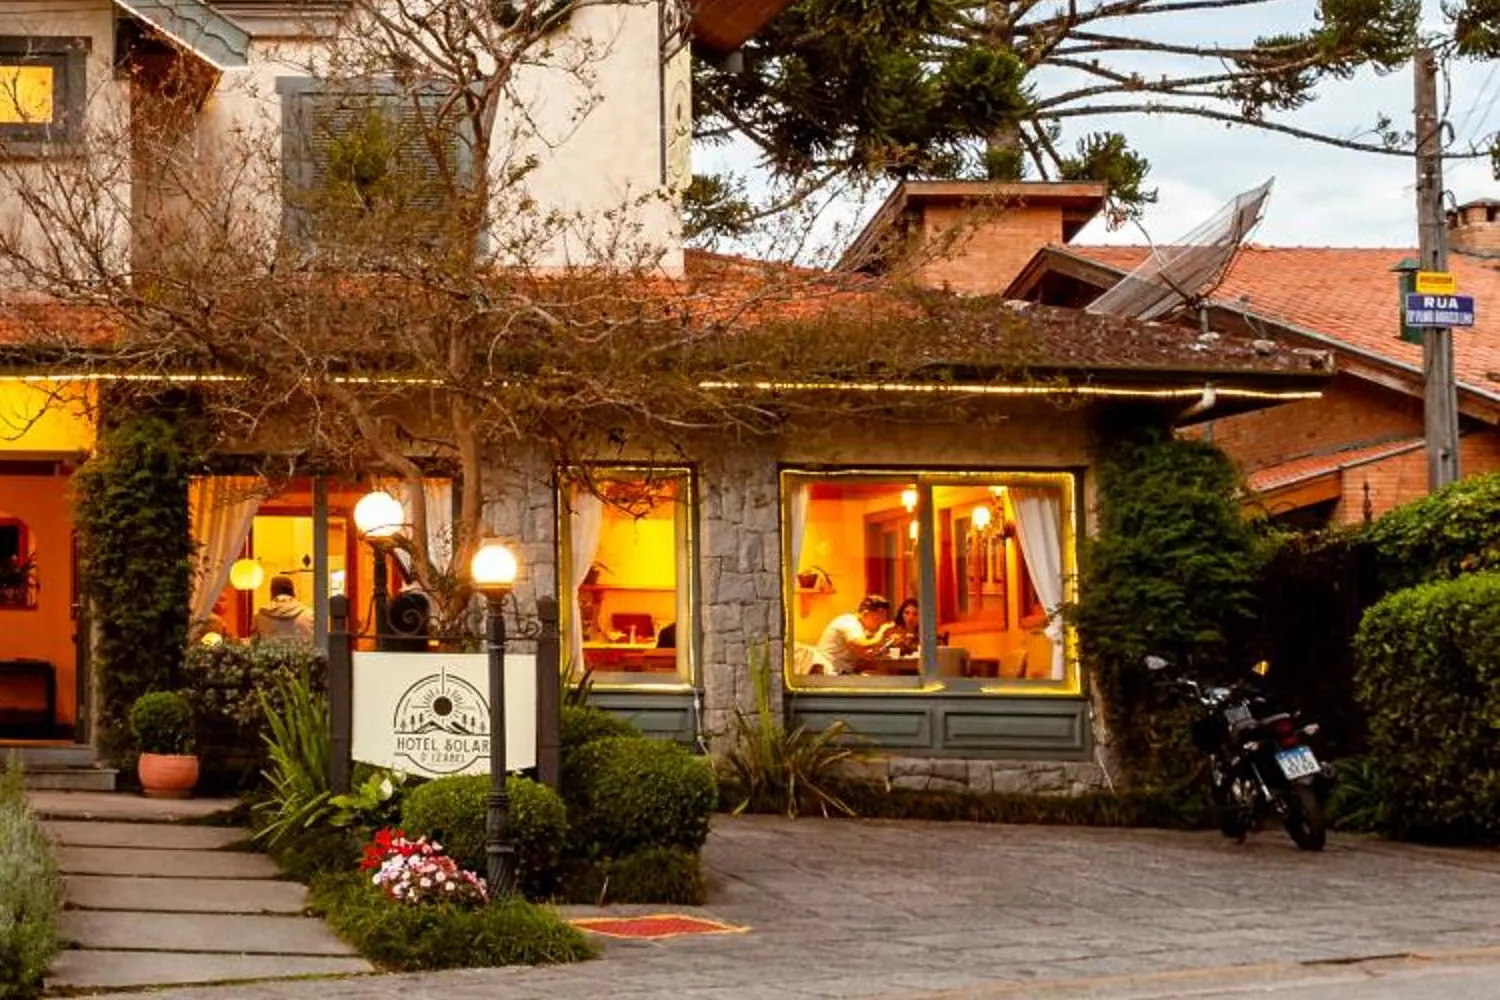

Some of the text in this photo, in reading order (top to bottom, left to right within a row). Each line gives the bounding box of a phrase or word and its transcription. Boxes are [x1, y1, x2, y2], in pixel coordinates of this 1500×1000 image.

[1423, 297, 1459, 309] RUA
[397, 737, 489, 753] HOTEL SOLAR
